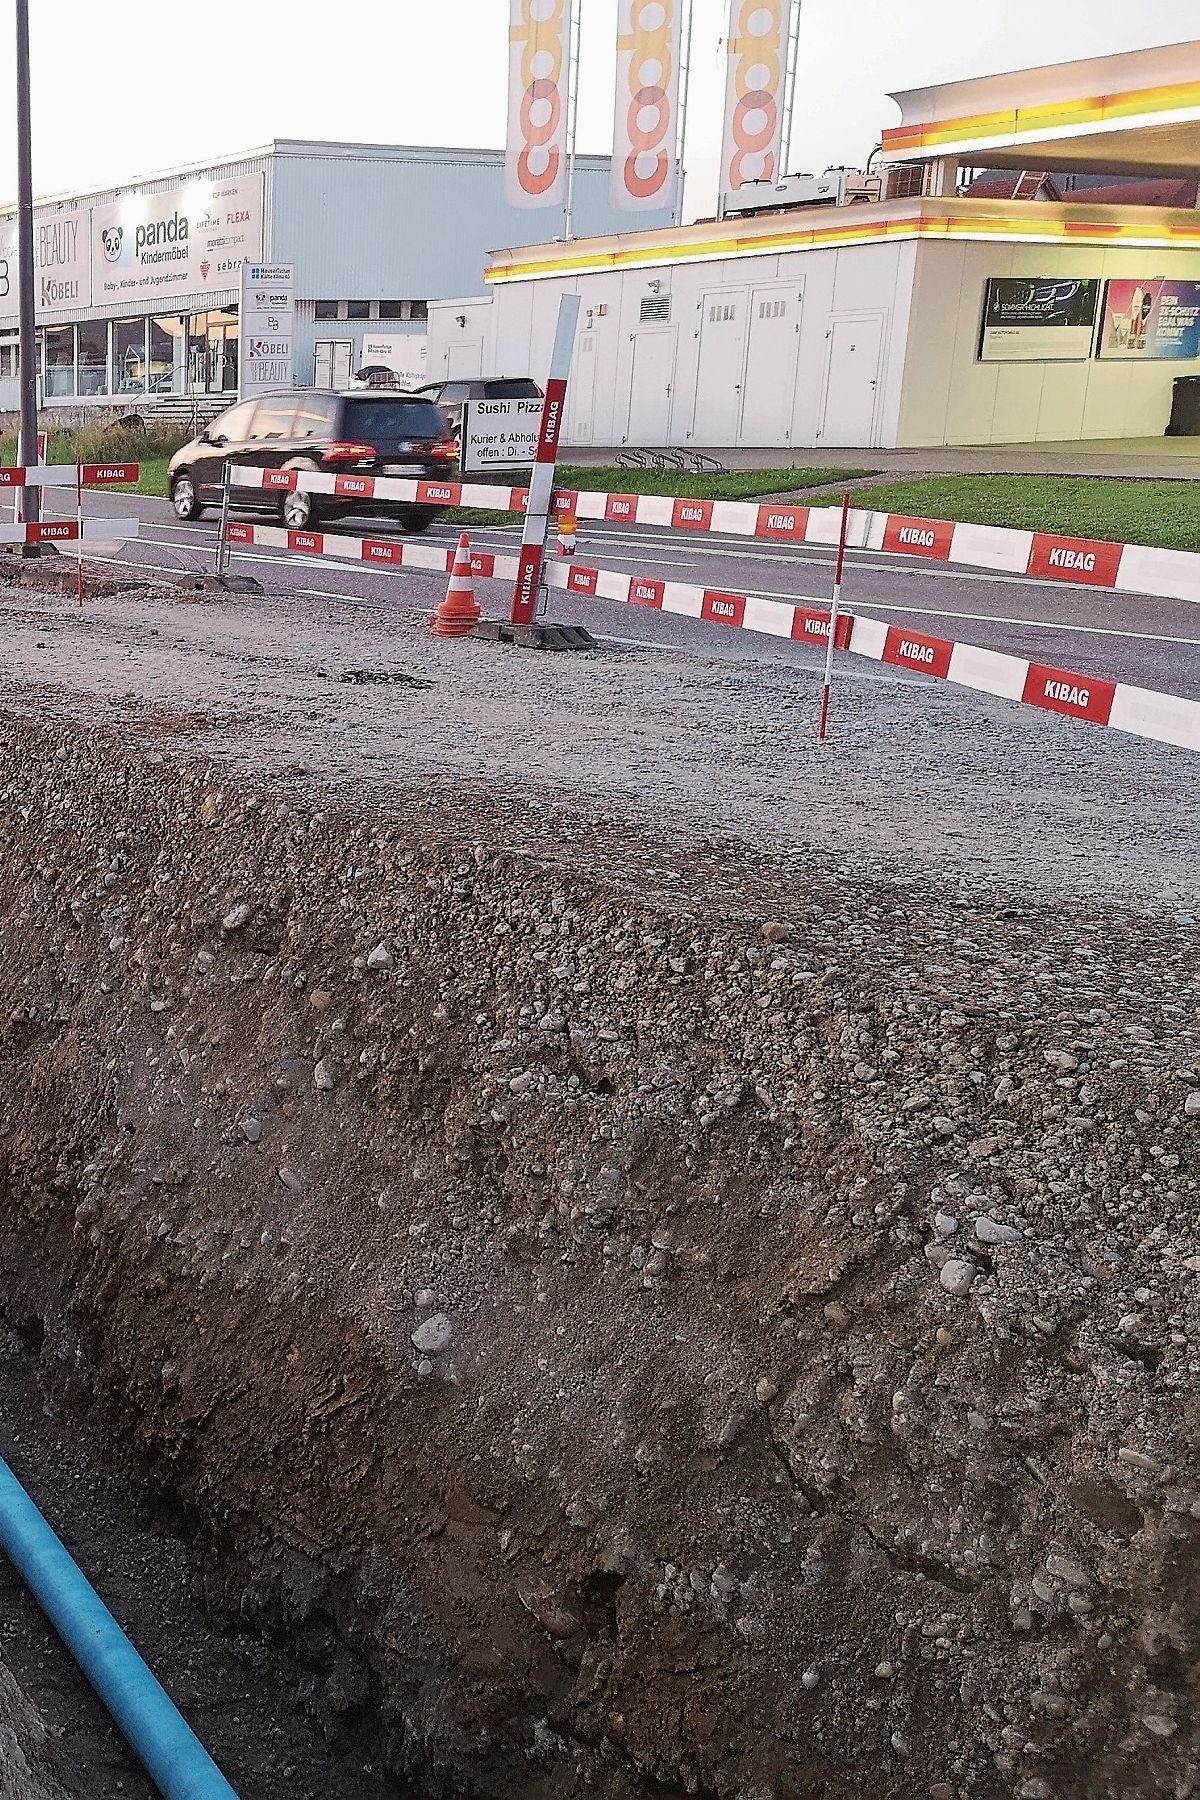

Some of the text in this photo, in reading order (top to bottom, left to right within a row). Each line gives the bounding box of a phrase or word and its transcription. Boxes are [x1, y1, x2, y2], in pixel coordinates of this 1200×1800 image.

[226, 210, 251, 225] FLEXA
[39, 219, 78, 268] BEAUTY
[135, 211, 189, 257] panda
[140, 245, 189, 265] Kindermöbel
[40, 275, 79, 307] KÖBELI
[269, 292, 288, 302] panda
[249, 338, 289, 357] KÖBELI
[477, 401, 511, 414] Sushi
[544, 401, 559, 443] KIBAG
[470, 432, 497, 444] Kurier
[499, 433, 506, 443] &
[477, 446, 499, 458] offen
[507, 446, 520, 457] Di.
[96, 468, 125, 479] KIBAG
[39, 526, 70, 537] KIBAG
[270, 474, 1097, 573] KIBAG KIBAG KIBAG KIBAG KIBAG KIBAG KIBAG KIBAG KIBAG
[520, 564, 535, 605] KIBAG
[230, 527, 247, 538] KIBAG
[296, 537, 315, 548] KIBAG
[370, 547, 392, 558] KIBAG
[574, 573, 591, 588] KIBAG
[636, 584, 656, 600] KIBAG
[711, 599, 735, 618] KIBAG
[899, 639, 935, 664] KIBAG
[1043, 679, 1091, 708] KIBAG
